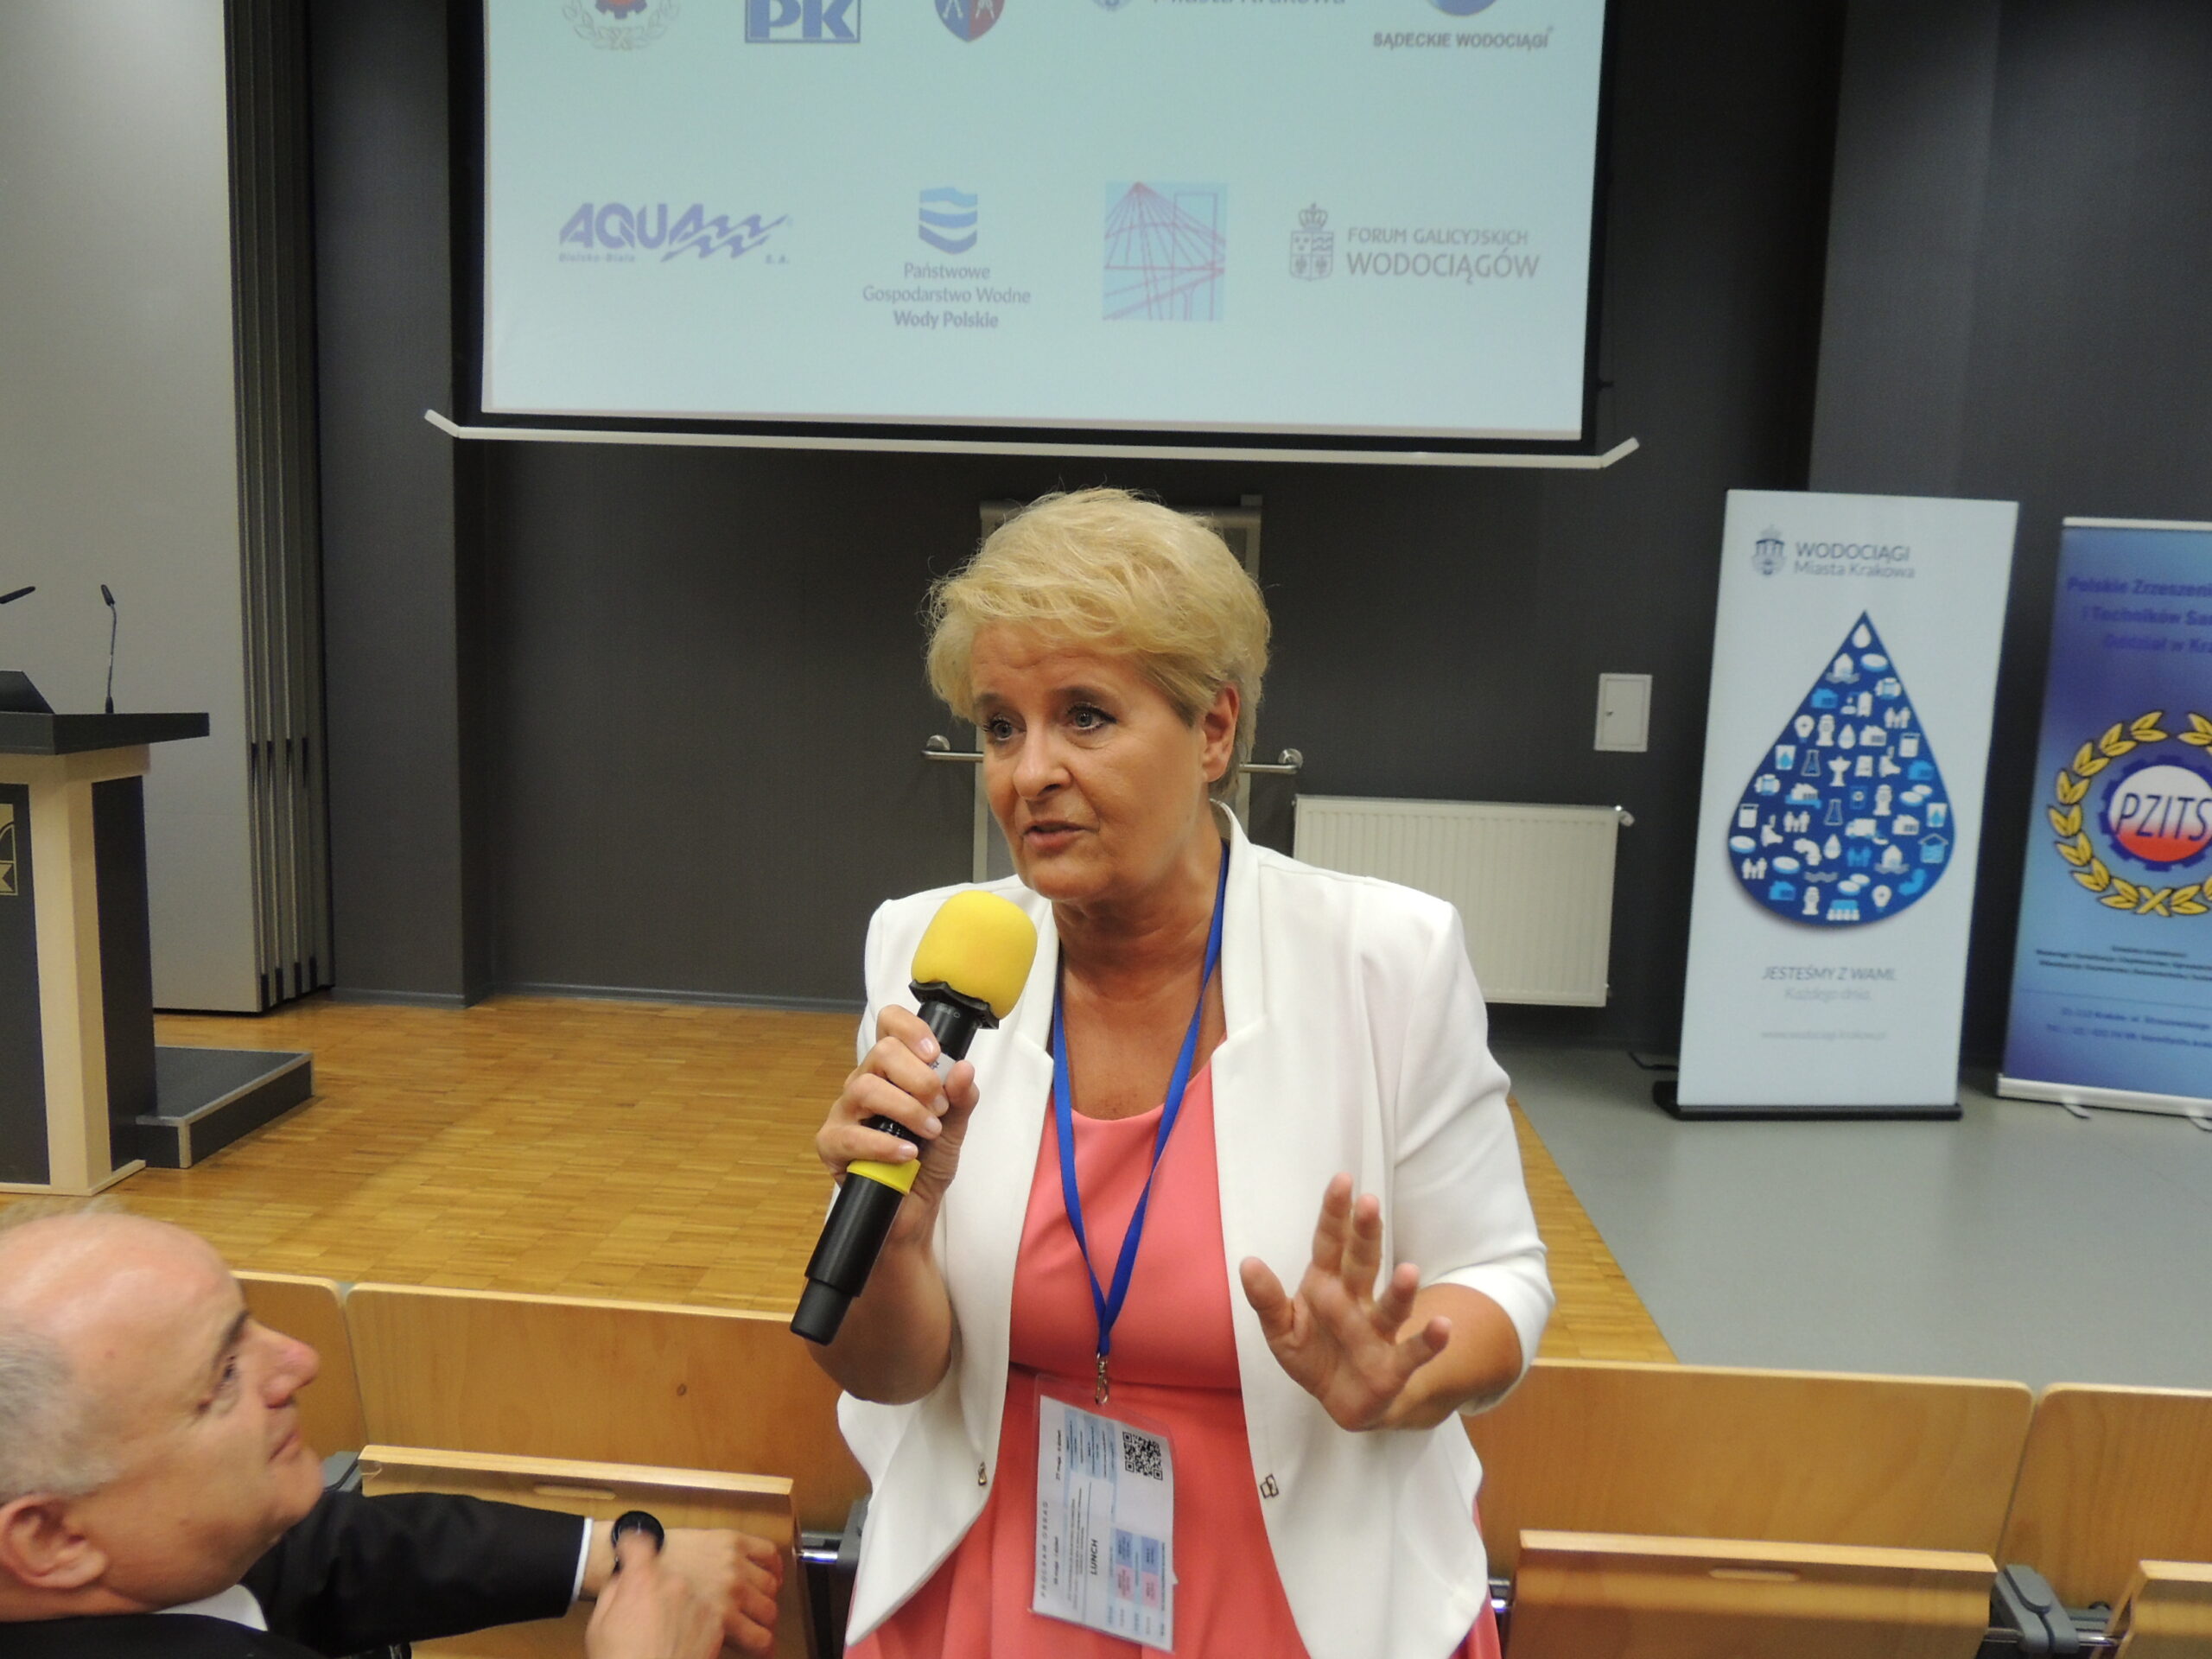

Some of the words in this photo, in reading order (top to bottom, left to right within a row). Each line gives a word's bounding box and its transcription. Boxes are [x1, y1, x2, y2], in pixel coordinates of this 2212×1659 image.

[749, 0, 855, 38] PK
[1373, 32, 1452, 50] SĄDECKIE
[1348, 227, 1408, 244] FORUM
[1413, 229, 1529, 245] GALICYJSKICH
[904, 263, 990, 279] Państwowe
[1346, 247, 1541, 284] WODOCIĄGÓW
[862, 285, 972, 304] Gospodarstwo
[976, 287, 1032, 303] Wodne
[893, 310, 938, 330] Wody
[943, 311, 999, 328] Polskie
[1796, 542, 1910, 563] WODOCIĄGI
[1794, 561, 1846, 575] Miasta
[1848, 563, 1916, 578] Krakowa
[2114, 792, 2212, 842] PZITS
[1762, 964, 1835, 981] JESTEŚMY
[1837, 967, 1848, 981] Z
[1090, 1538, 1099, 1577] LUNCH
